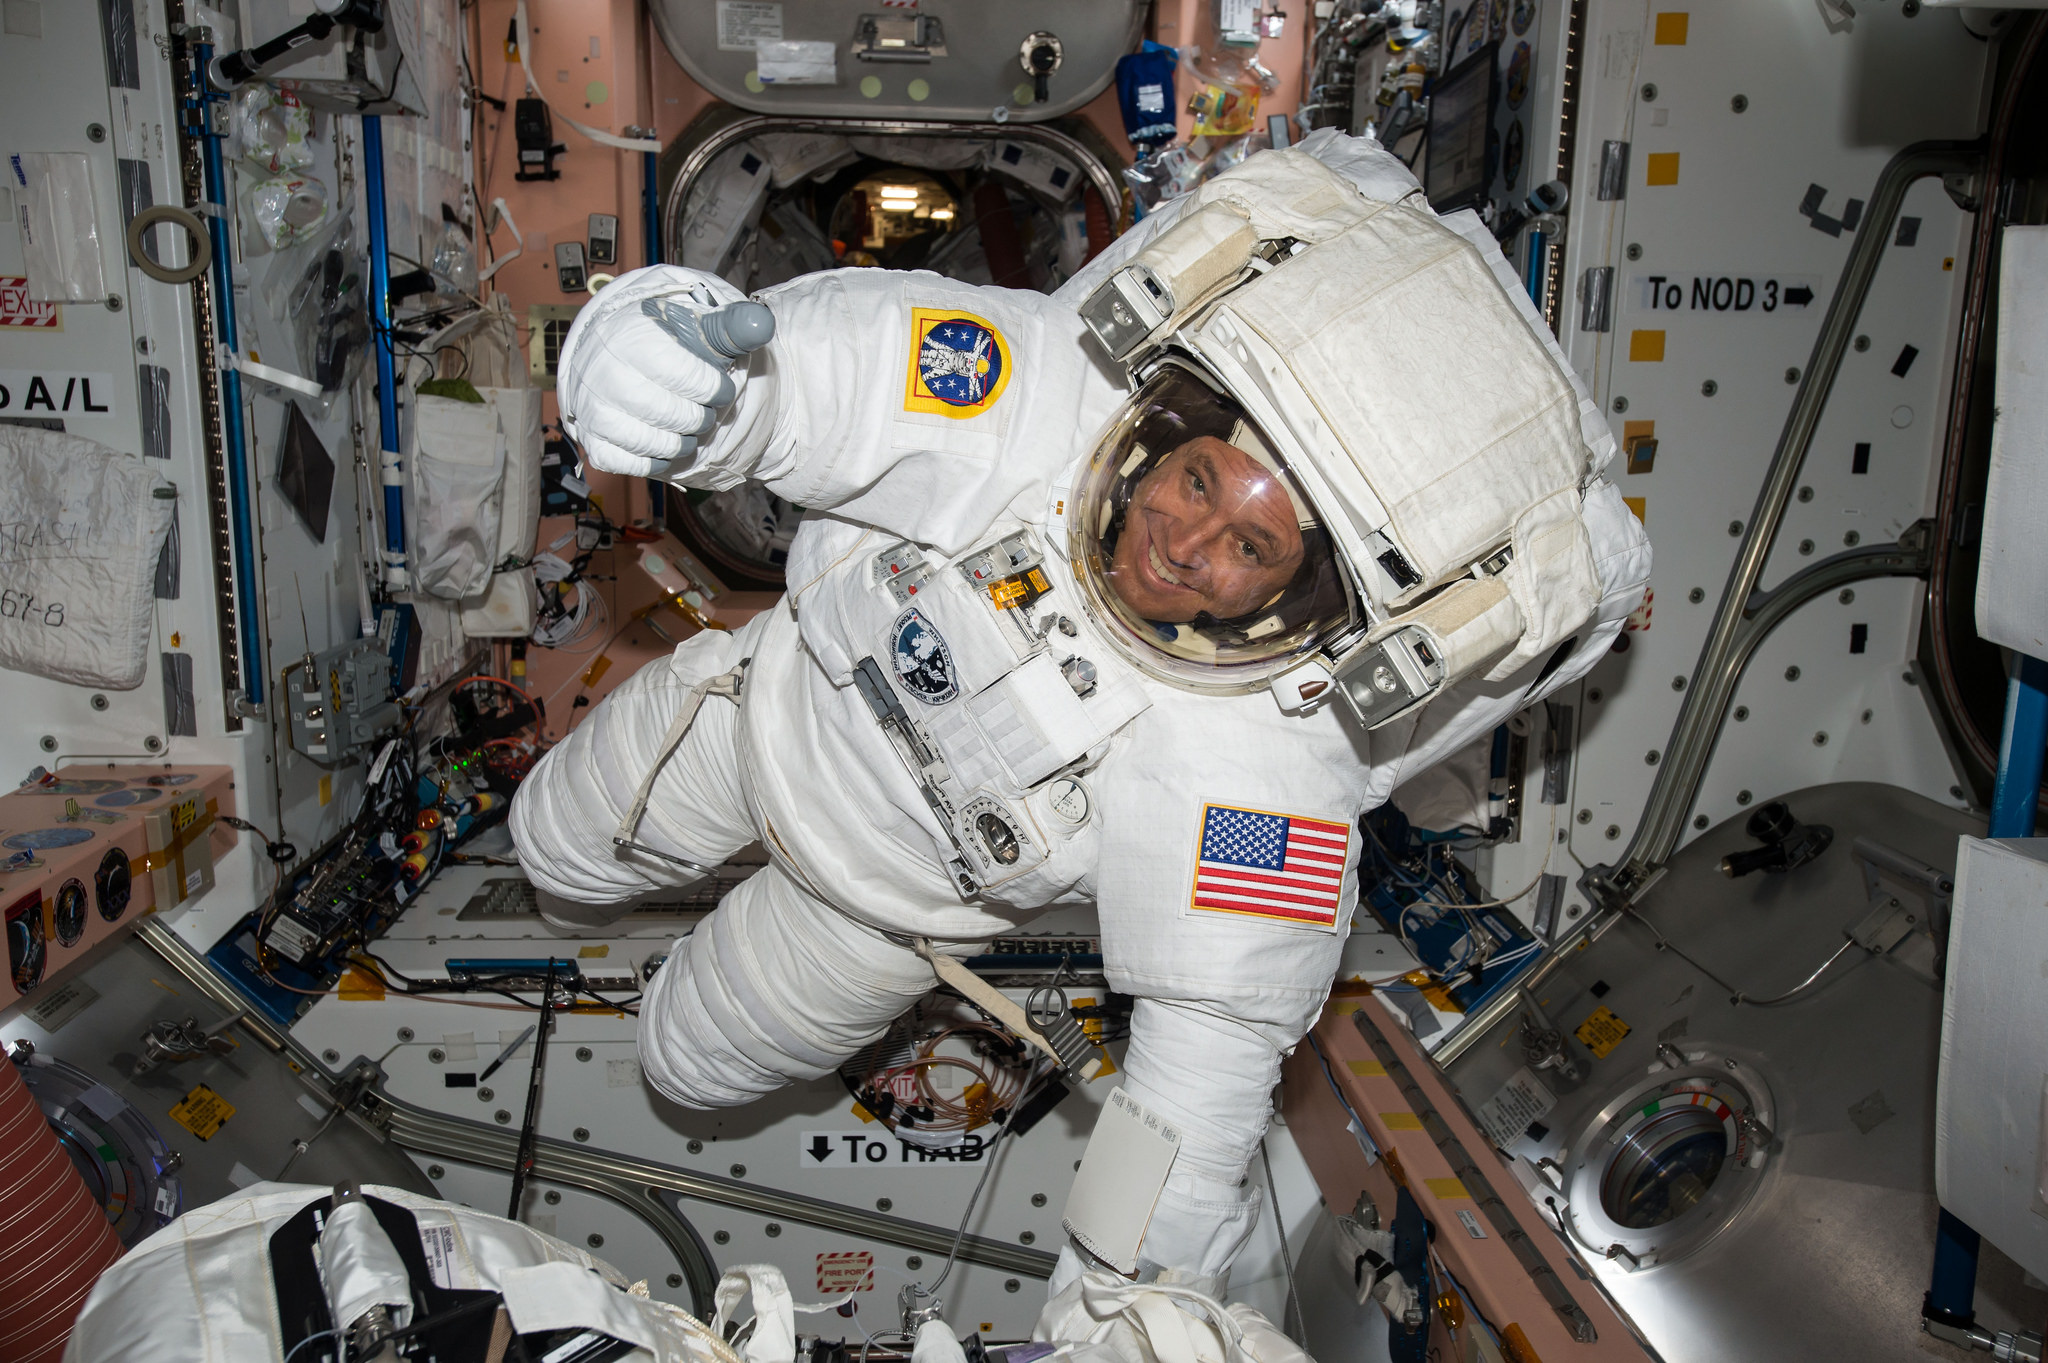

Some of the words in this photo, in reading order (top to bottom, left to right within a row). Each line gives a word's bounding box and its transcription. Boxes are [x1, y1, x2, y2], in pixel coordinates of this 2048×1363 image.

[1649, 276, 1682, 310] To
[1691, 277, 1755, 311] NOD
[1762, 279, 1778, 312] 3
[24, 376, 108, 412] A/L
[842, 1136, 888, 1162] To
